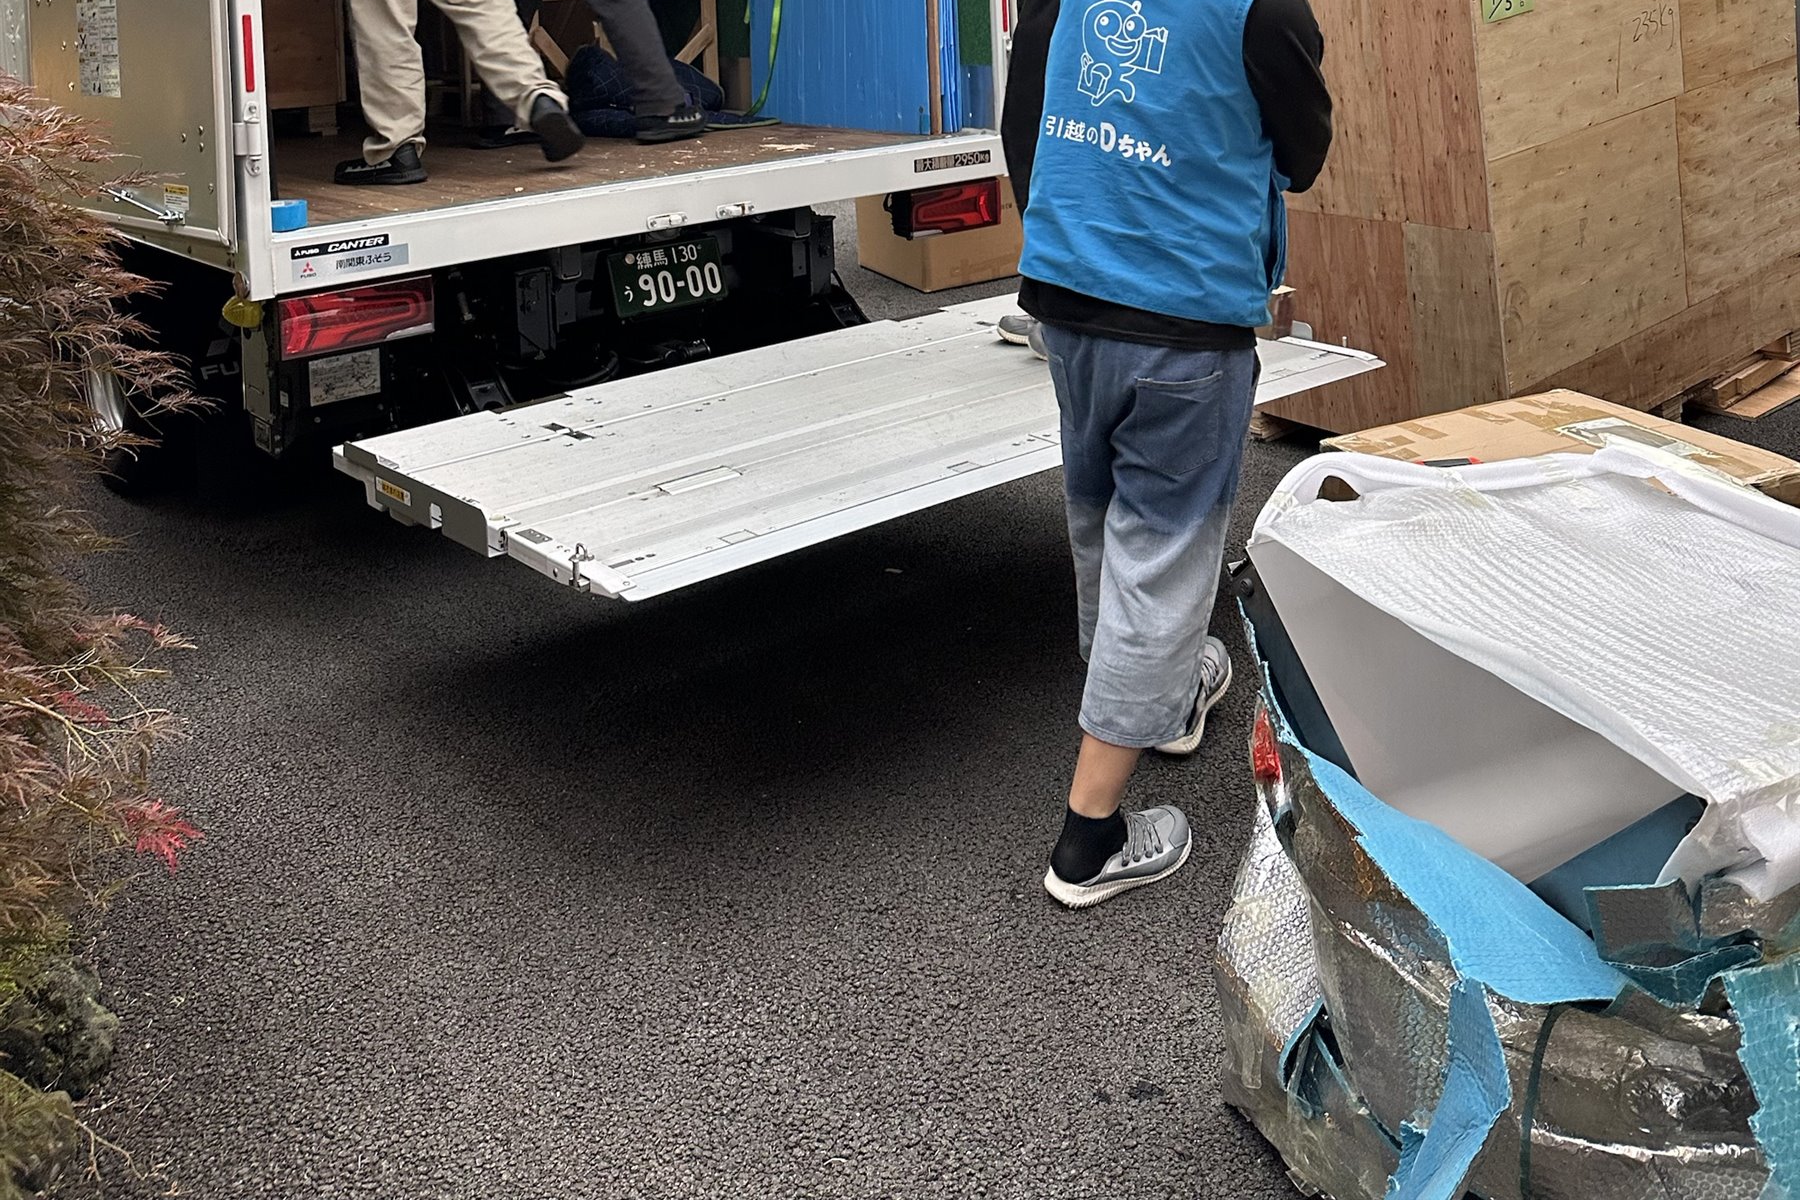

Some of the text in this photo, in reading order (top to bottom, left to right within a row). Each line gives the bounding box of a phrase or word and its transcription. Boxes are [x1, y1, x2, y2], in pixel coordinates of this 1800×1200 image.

[1045, 115, 1172, 167] 引越のDちゃん
[327, 236, 385, 252] CANTER
[636, 244, 698, 270] 練馬 130
[624, 262, 722, 307] う 90-00
[200, 361, 240, 380] FU
